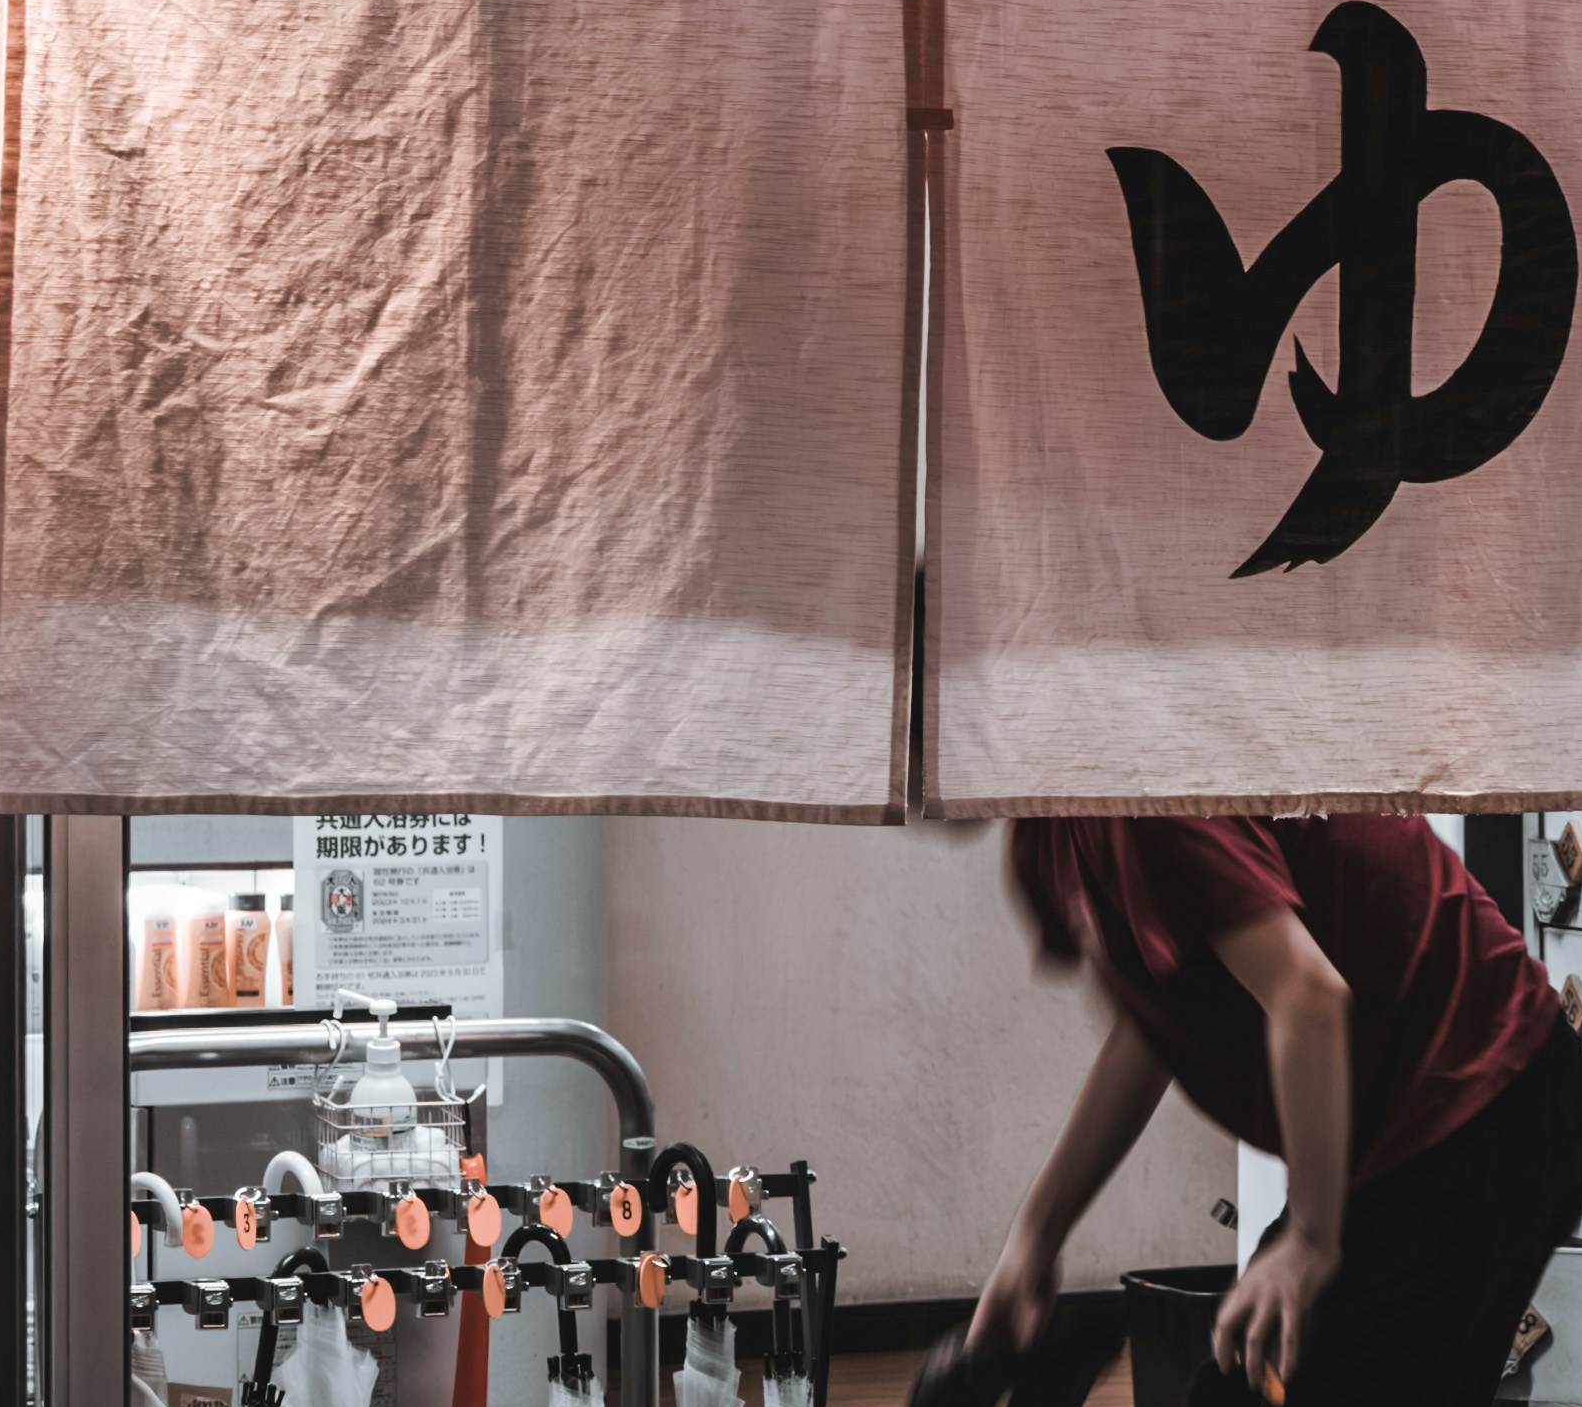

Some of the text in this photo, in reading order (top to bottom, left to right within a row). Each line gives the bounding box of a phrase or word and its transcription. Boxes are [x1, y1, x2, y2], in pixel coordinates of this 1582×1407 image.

[1105, 0, 1579, 580] ゆ
[622, 1200, 631, 1221] 8
[243, 1213, 251, 1234] 3
